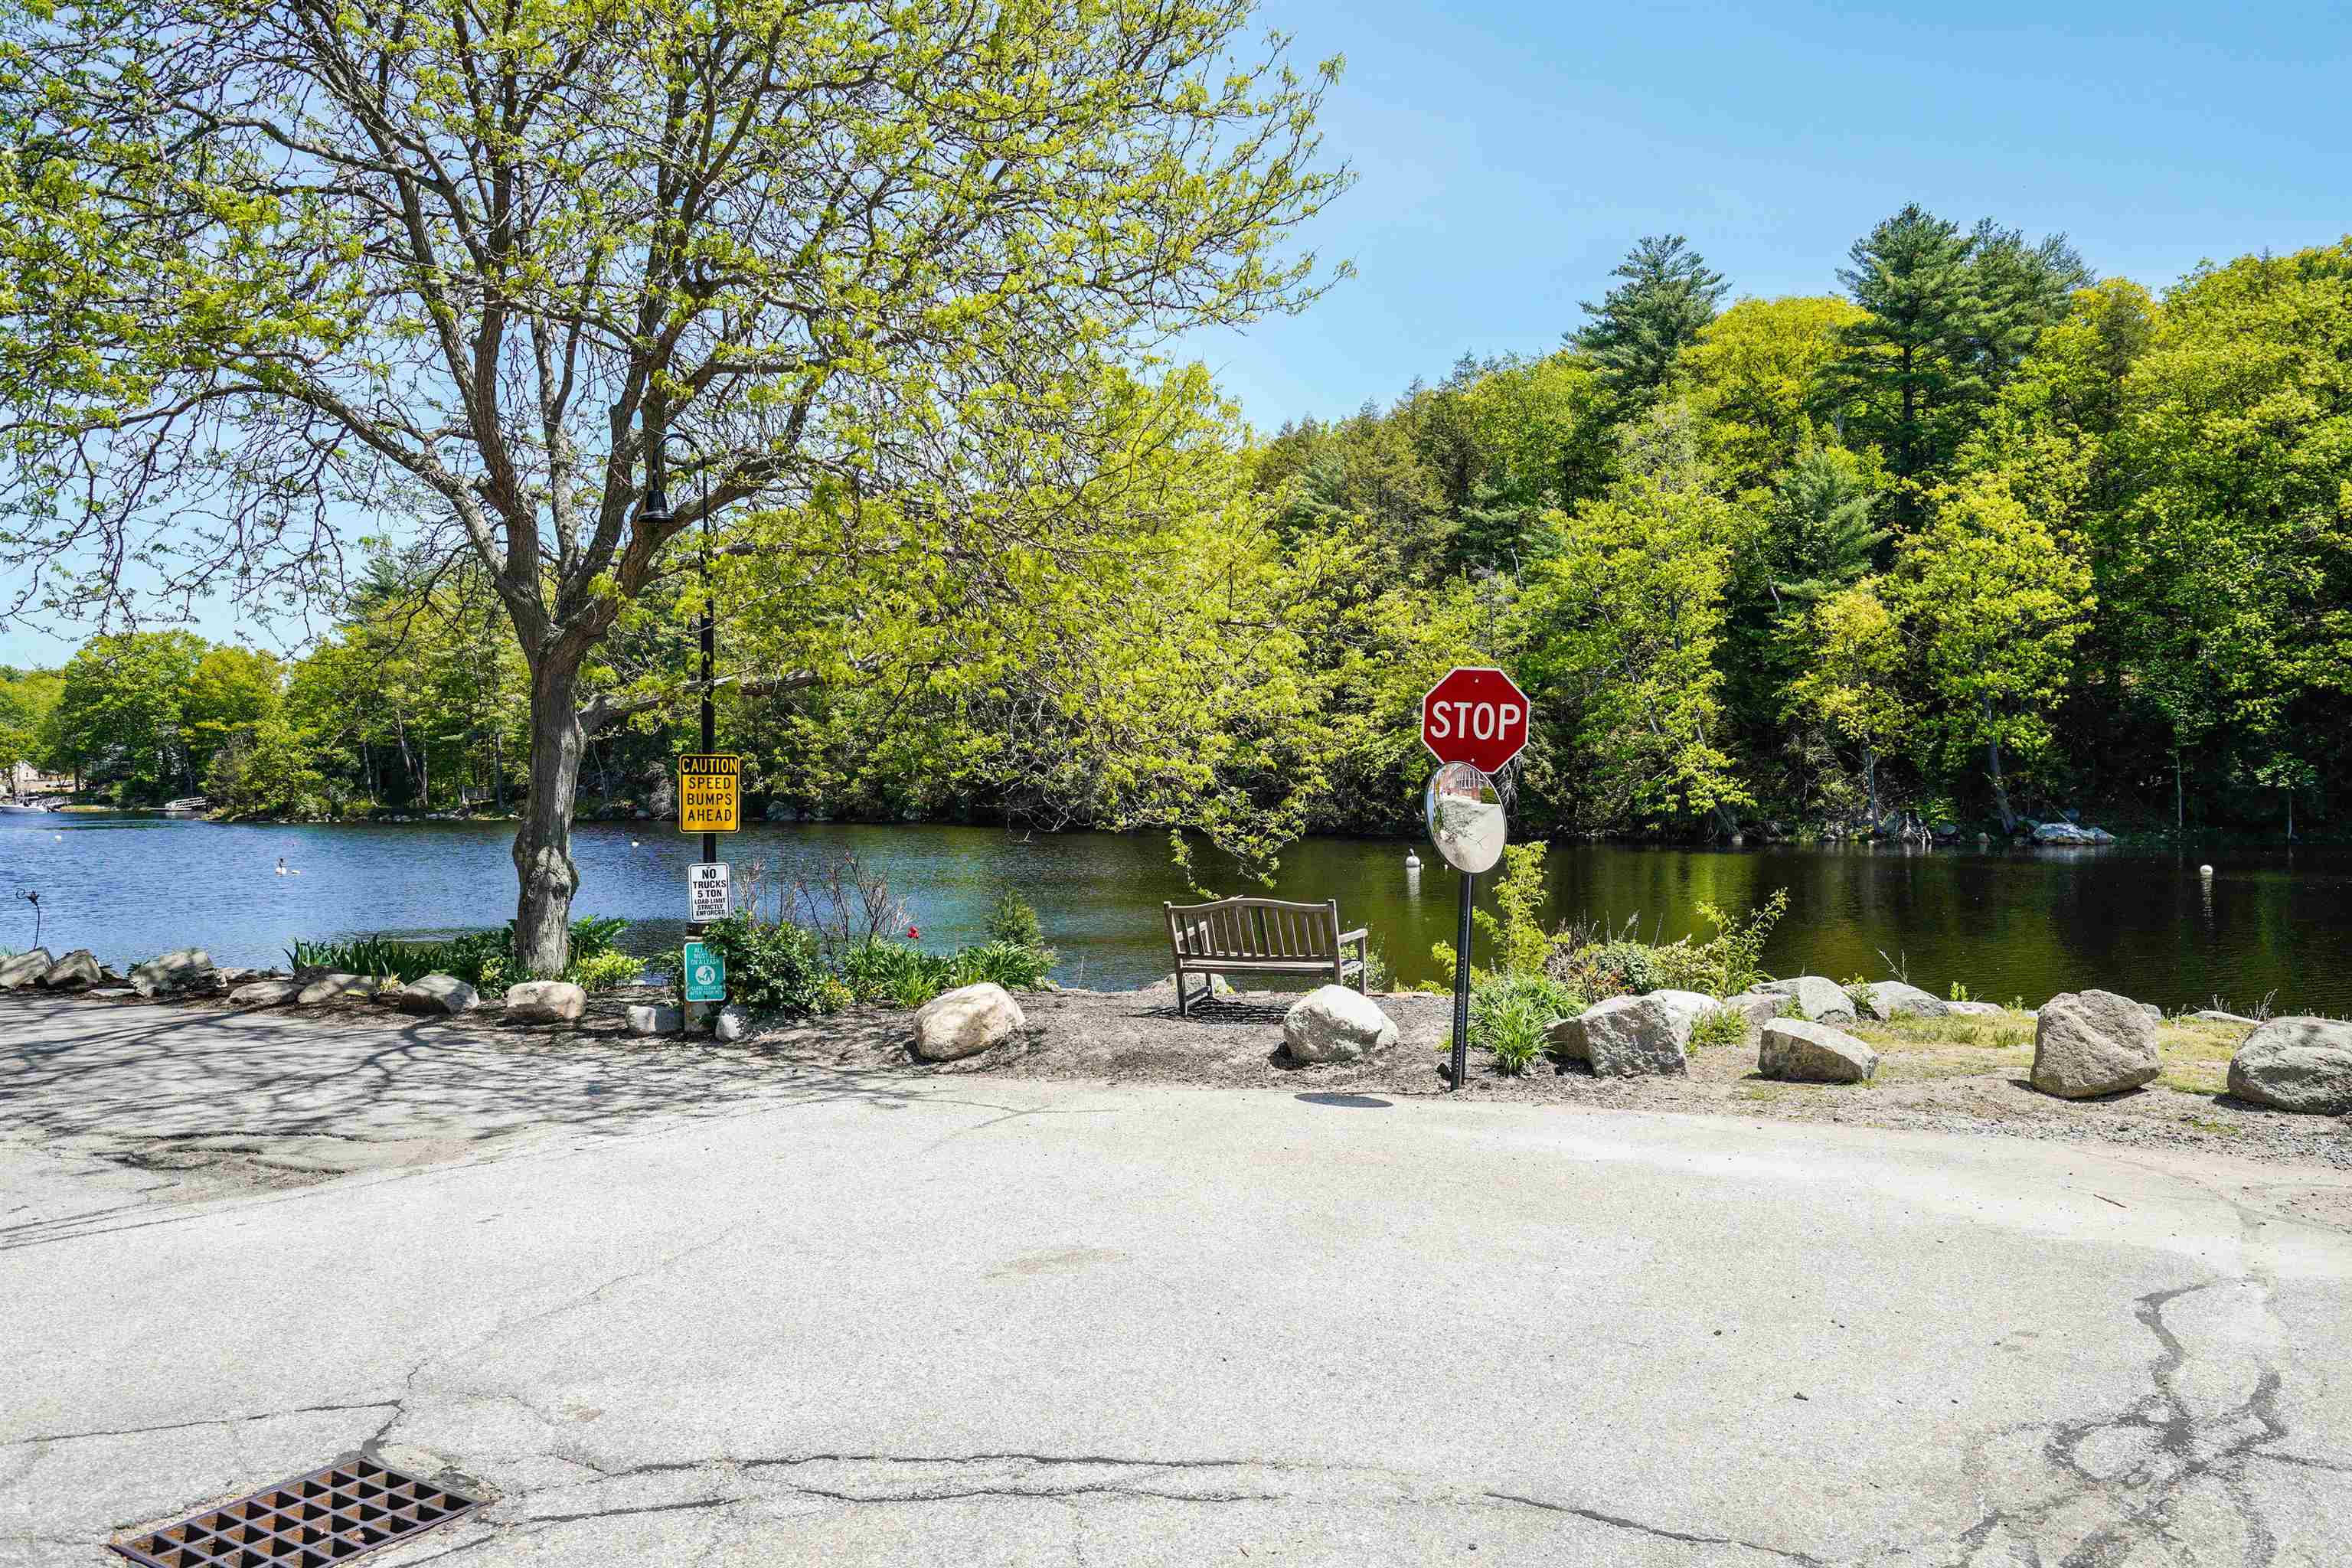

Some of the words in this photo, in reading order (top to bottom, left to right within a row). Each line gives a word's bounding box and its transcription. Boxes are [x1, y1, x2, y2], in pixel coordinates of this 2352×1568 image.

[1429, 701, 1521, 740] STOP
[681, 758, 737, 773] CAUTION
[688, 777, 730, 789] SPEED
[687, 792, 732, 805] BUMPS
[688, 808, 732, 822] AHEAD
[702, 868, 716, 879] NO
[692, 880, 727, 888] TRUCKS
[697, 890, 703, 898] 5
[706, 889, 722, 898] TON
